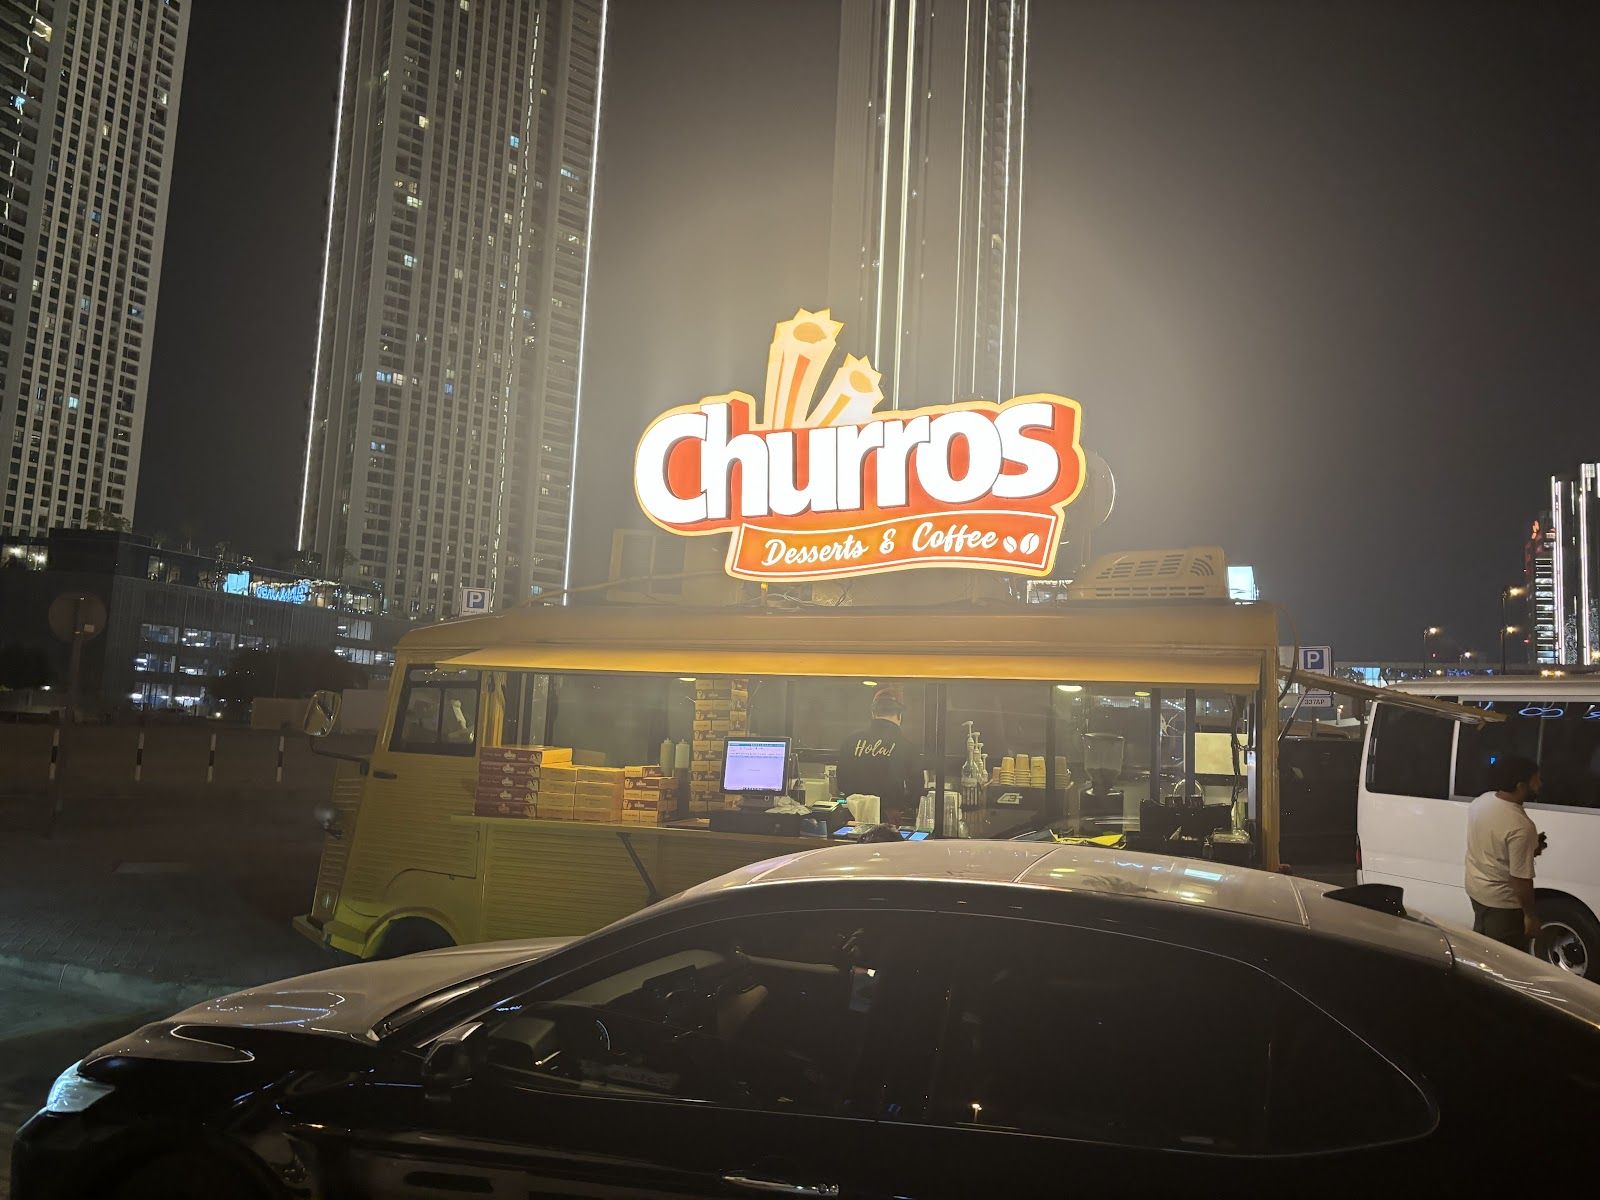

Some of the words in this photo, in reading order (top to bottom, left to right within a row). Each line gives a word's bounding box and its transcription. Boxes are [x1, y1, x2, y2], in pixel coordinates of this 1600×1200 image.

[635, 402, 1058, 524] Churros
[761, 534, 869, 566] Desserts
[879, 528, 897, 555] &
[912, 521, 999, 553] Coffee
[469, 592, 482, 607] P
[1307, 651, 1320, 668] P
[854, 739, 896, 757] Hola!
